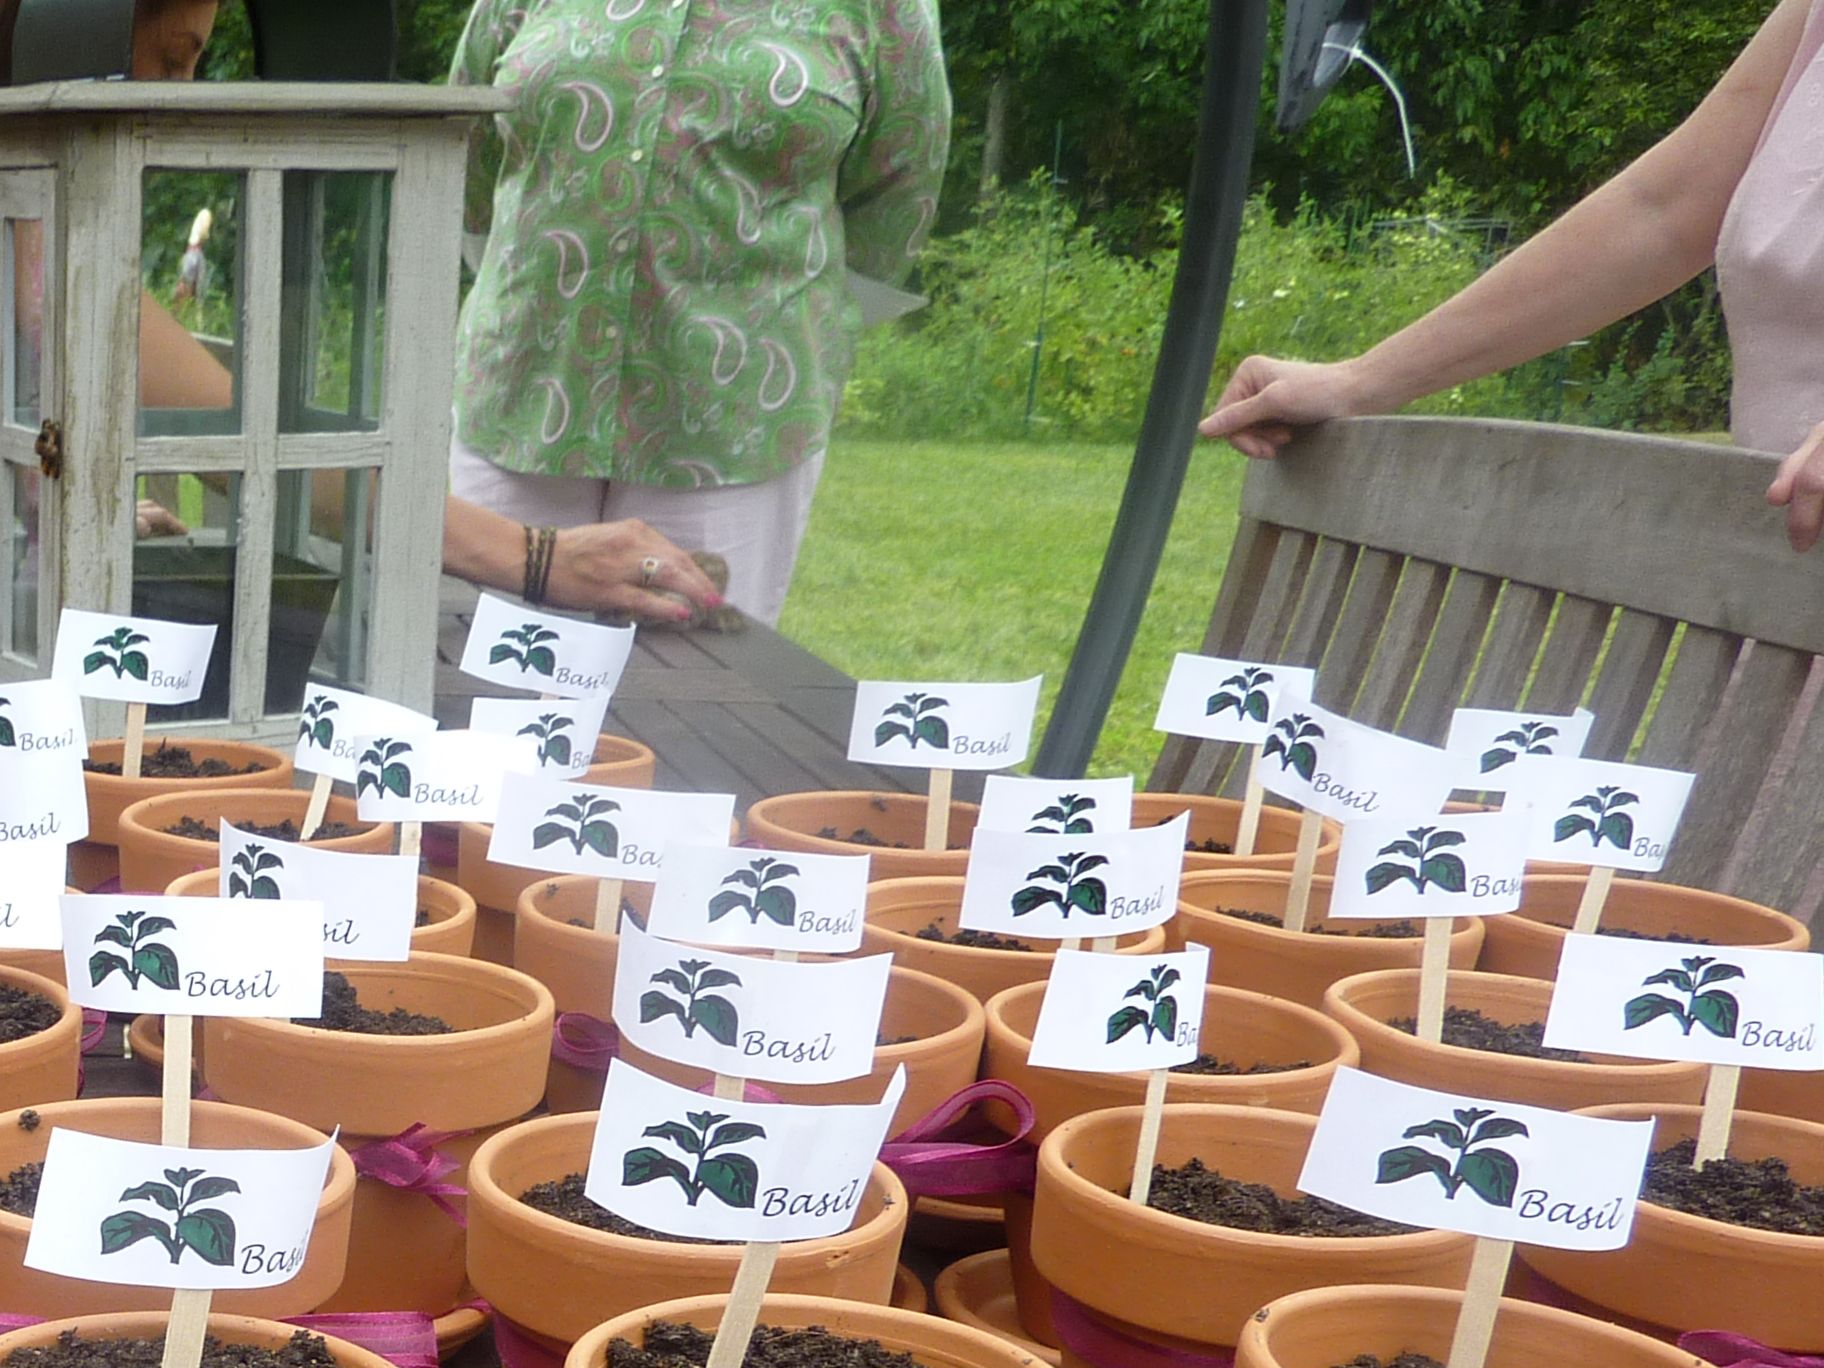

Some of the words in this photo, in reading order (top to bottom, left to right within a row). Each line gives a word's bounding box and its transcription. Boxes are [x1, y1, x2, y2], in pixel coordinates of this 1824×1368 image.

[151, 670, 191, 689] Basil
[19, 729, 76, 750] Basil
[954, 732, 1011, 754] Basil
[415, 783, 484, 805] Basil
[1313, 773, 1380, 812] Basil
[1111, 887, 1164, 919] Basil
[324, 919, 360, 944] sil
[800, 911, 855, 934] Basil
[185, 970, 280, 999] Basil
[743, 1031, 835, 1062] Basil
[1741, 1021, 1816, 1052] Basil
[763, 1179, 860, 1218] Basil
[1520, 1189, 1625, 1230] Basil
